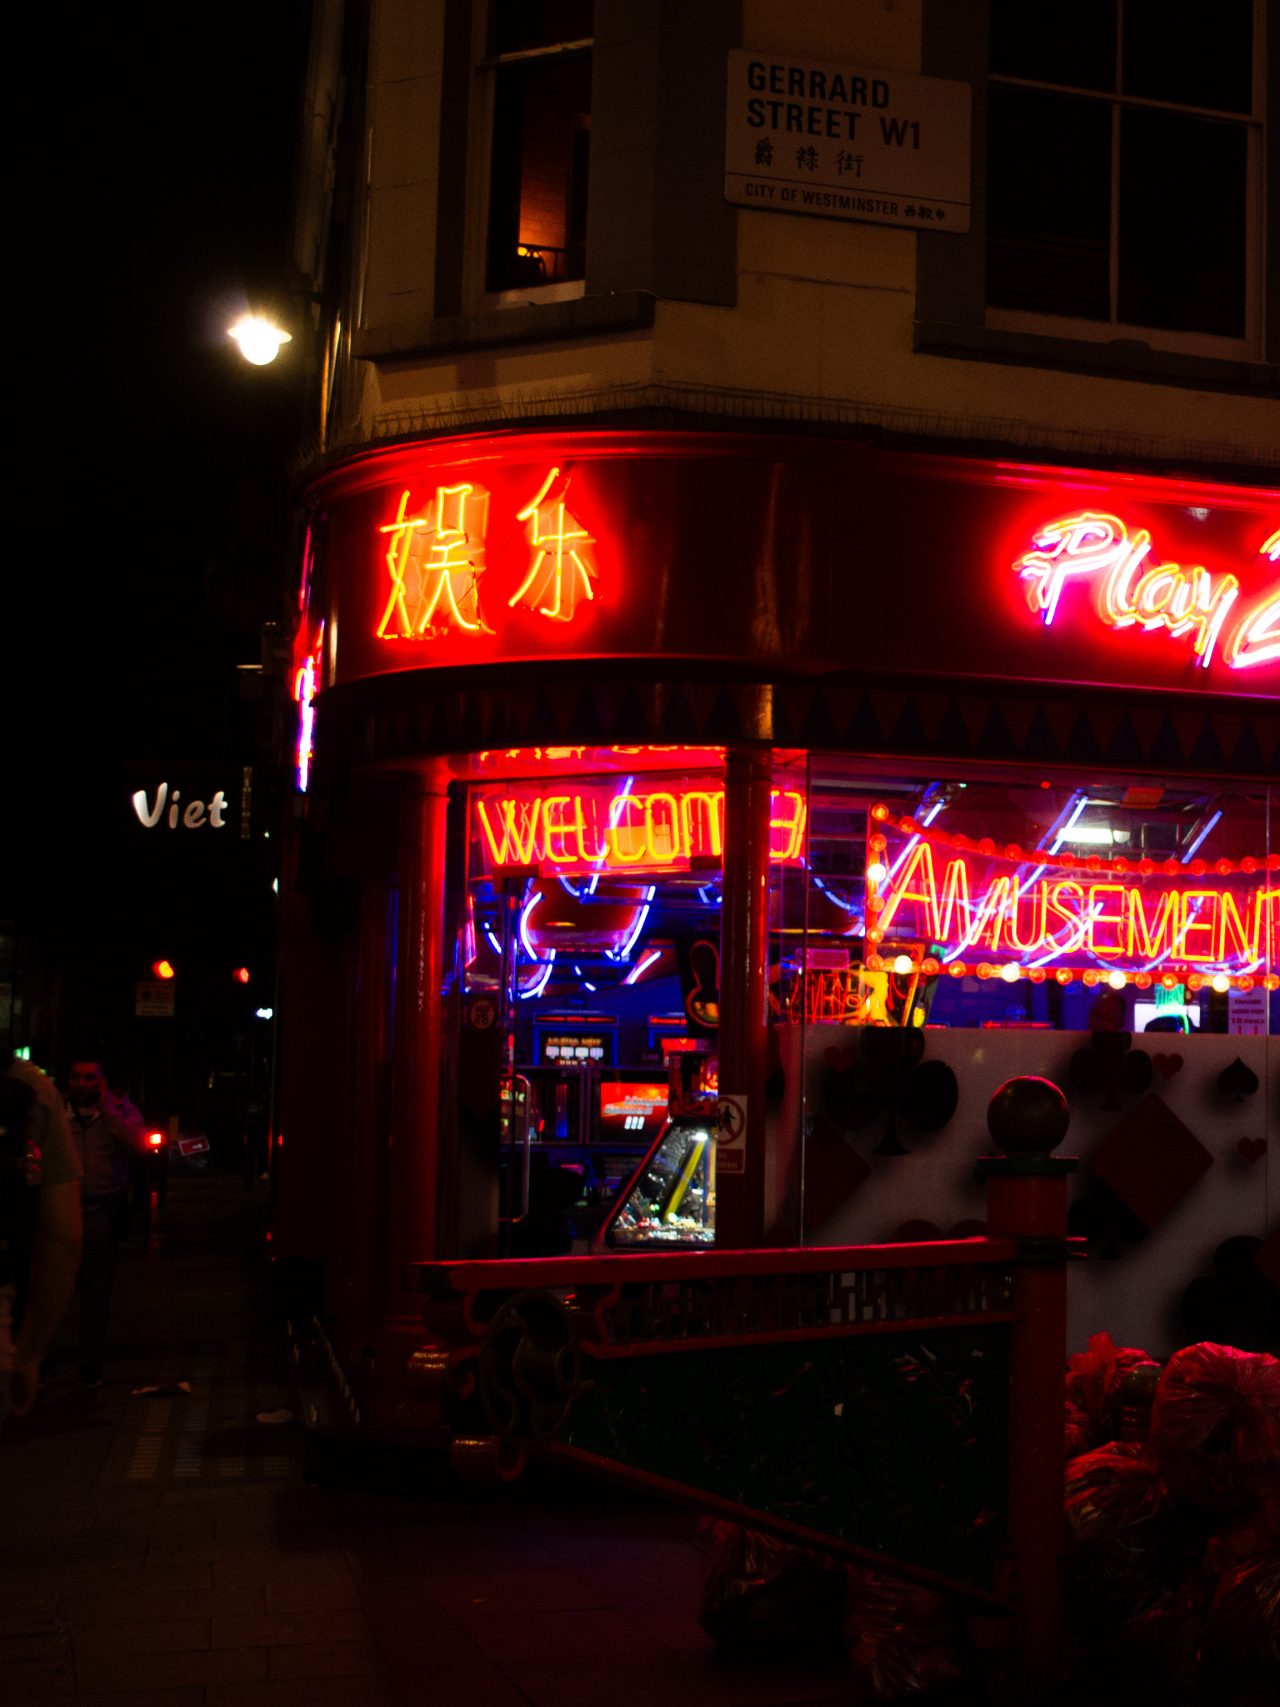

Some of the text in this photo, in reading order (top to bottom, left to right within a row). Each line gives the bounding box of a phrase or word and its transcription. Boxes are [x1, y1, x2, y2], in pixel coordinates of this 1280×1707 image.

[747, 61, 890, 109] GERRARD
[747, 98, 920, 149] STREET W1
[745, 183, 898, 217] CITY OF WESTMINSTER
[1018, 511, 1238, 668] Play
[132, 781, 229, 830] Viet
